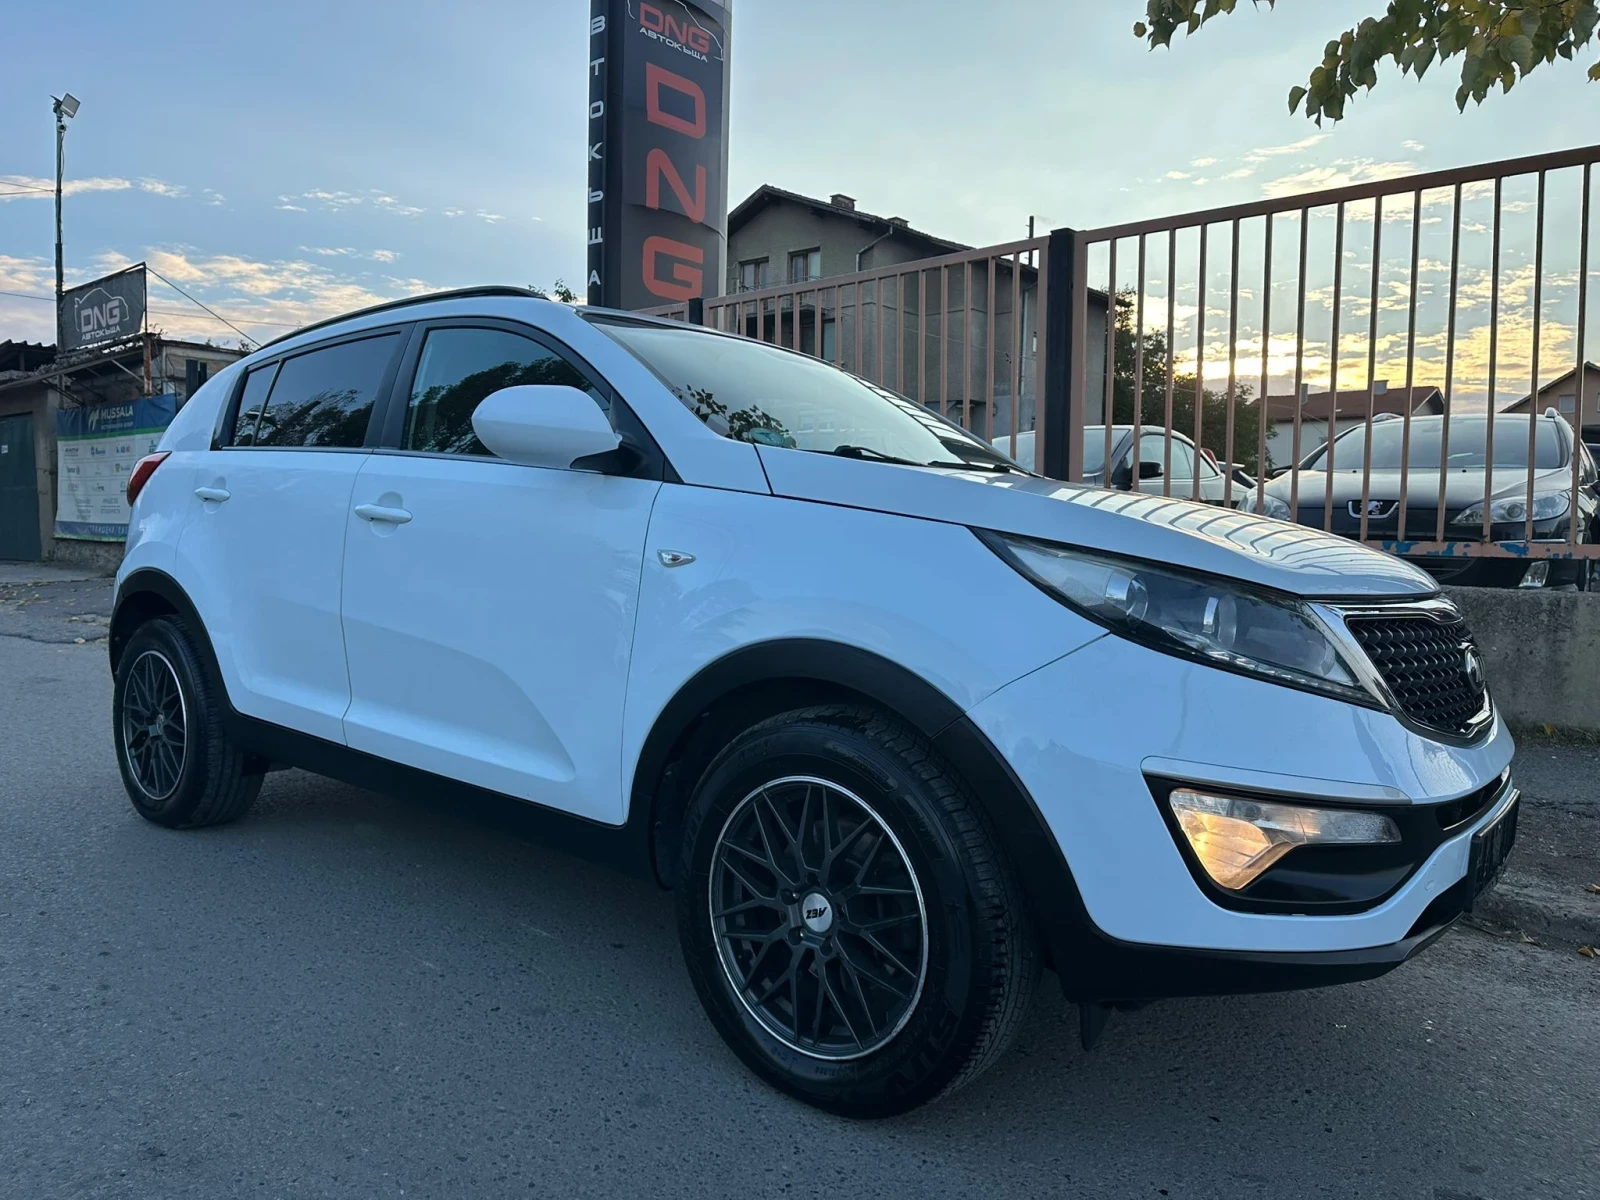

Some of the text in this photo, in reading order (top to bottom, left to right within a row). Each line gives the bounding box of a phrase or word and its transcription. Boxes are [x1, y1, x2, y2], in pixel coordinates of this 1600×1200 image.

[640, 2, 709, 54] DNG
[640, 27, 708, 63] АВТОКЪЩА
[643, 61, 706, 301] DNG
[80, 299, 120, 332] DNG
[100, 405, 134, 420] MUSSALA
[806, 907, 828, 920] AEZ
